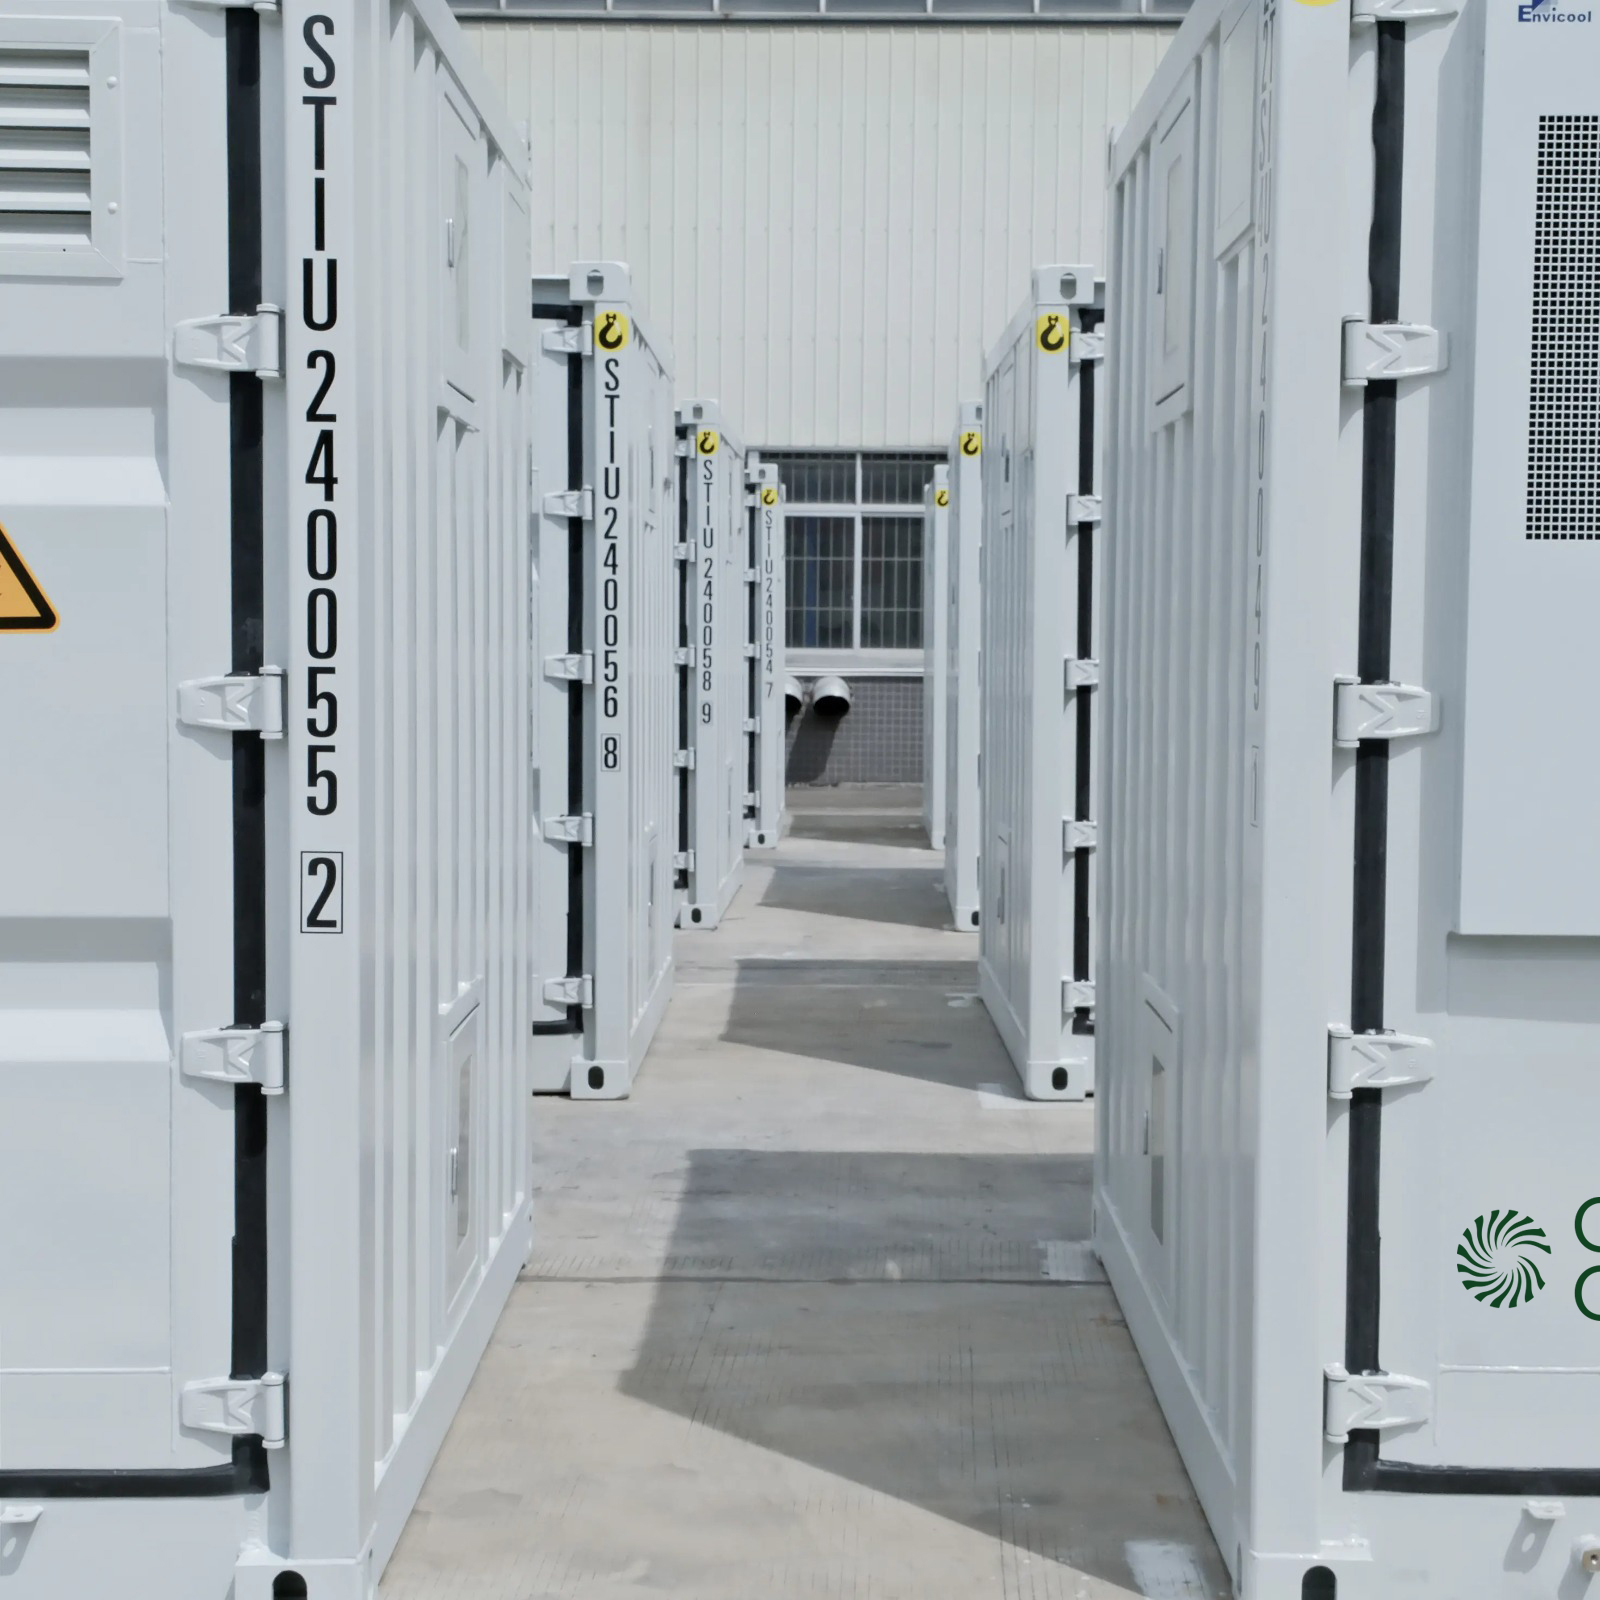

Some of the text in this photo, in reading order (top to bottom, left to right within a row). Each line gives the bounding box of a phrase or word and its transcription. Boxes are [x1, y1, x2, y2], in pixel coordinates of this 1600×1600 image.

[1516, 4, 1592, 23] Envicool
[602, 736, 619, 770] 8
[304, 857, 339, 929] 2
